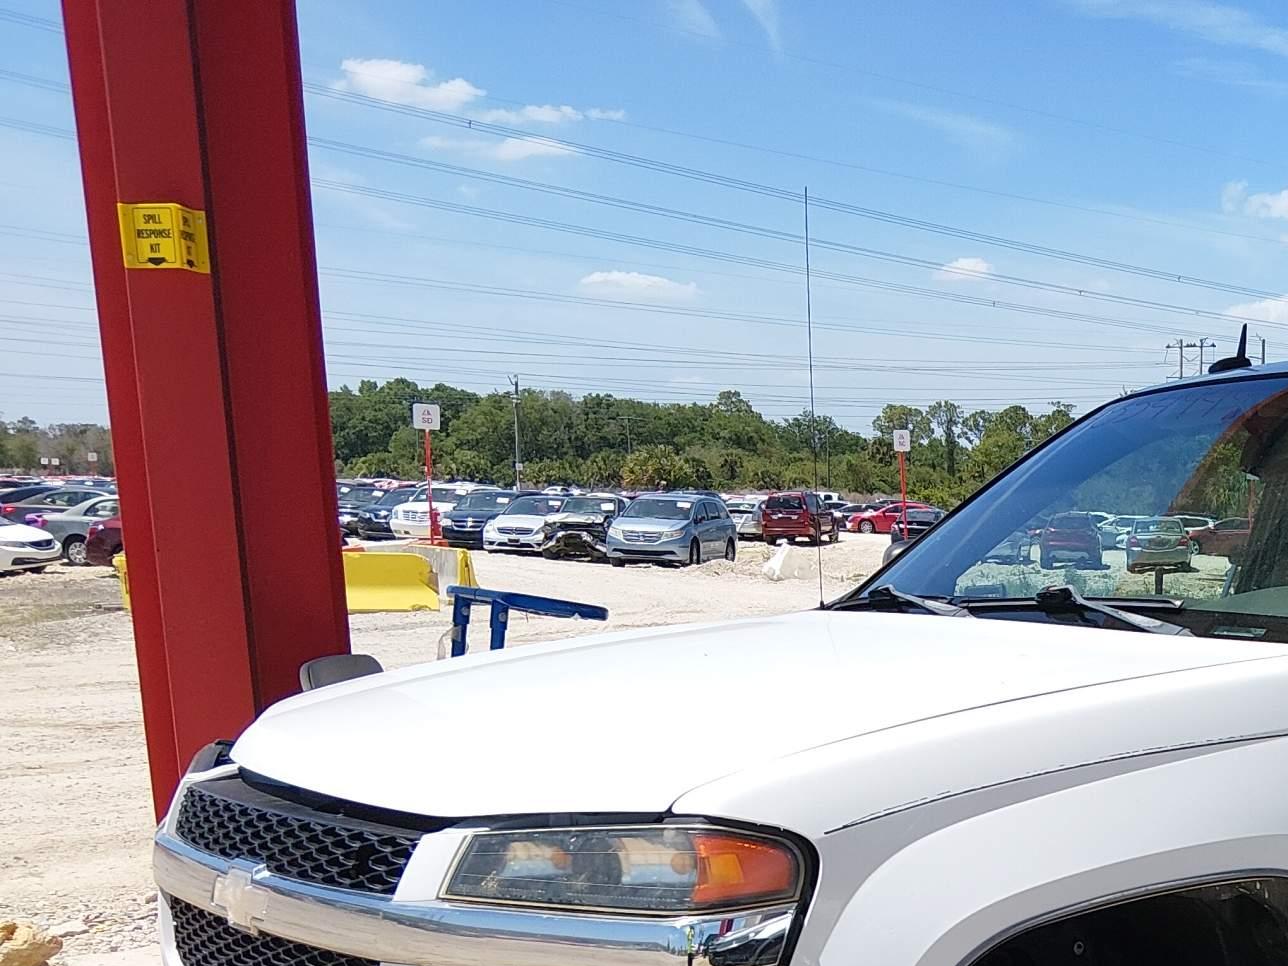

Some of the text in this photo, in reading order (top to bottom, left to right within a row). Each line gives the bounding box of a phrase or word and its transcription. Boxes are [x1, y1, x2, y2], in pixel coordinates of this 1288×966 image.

[143, 213, 162, 225] SPILL
[136, 228, 172, 239] RESPONSE
[149, 243, 161, 253] KIT
